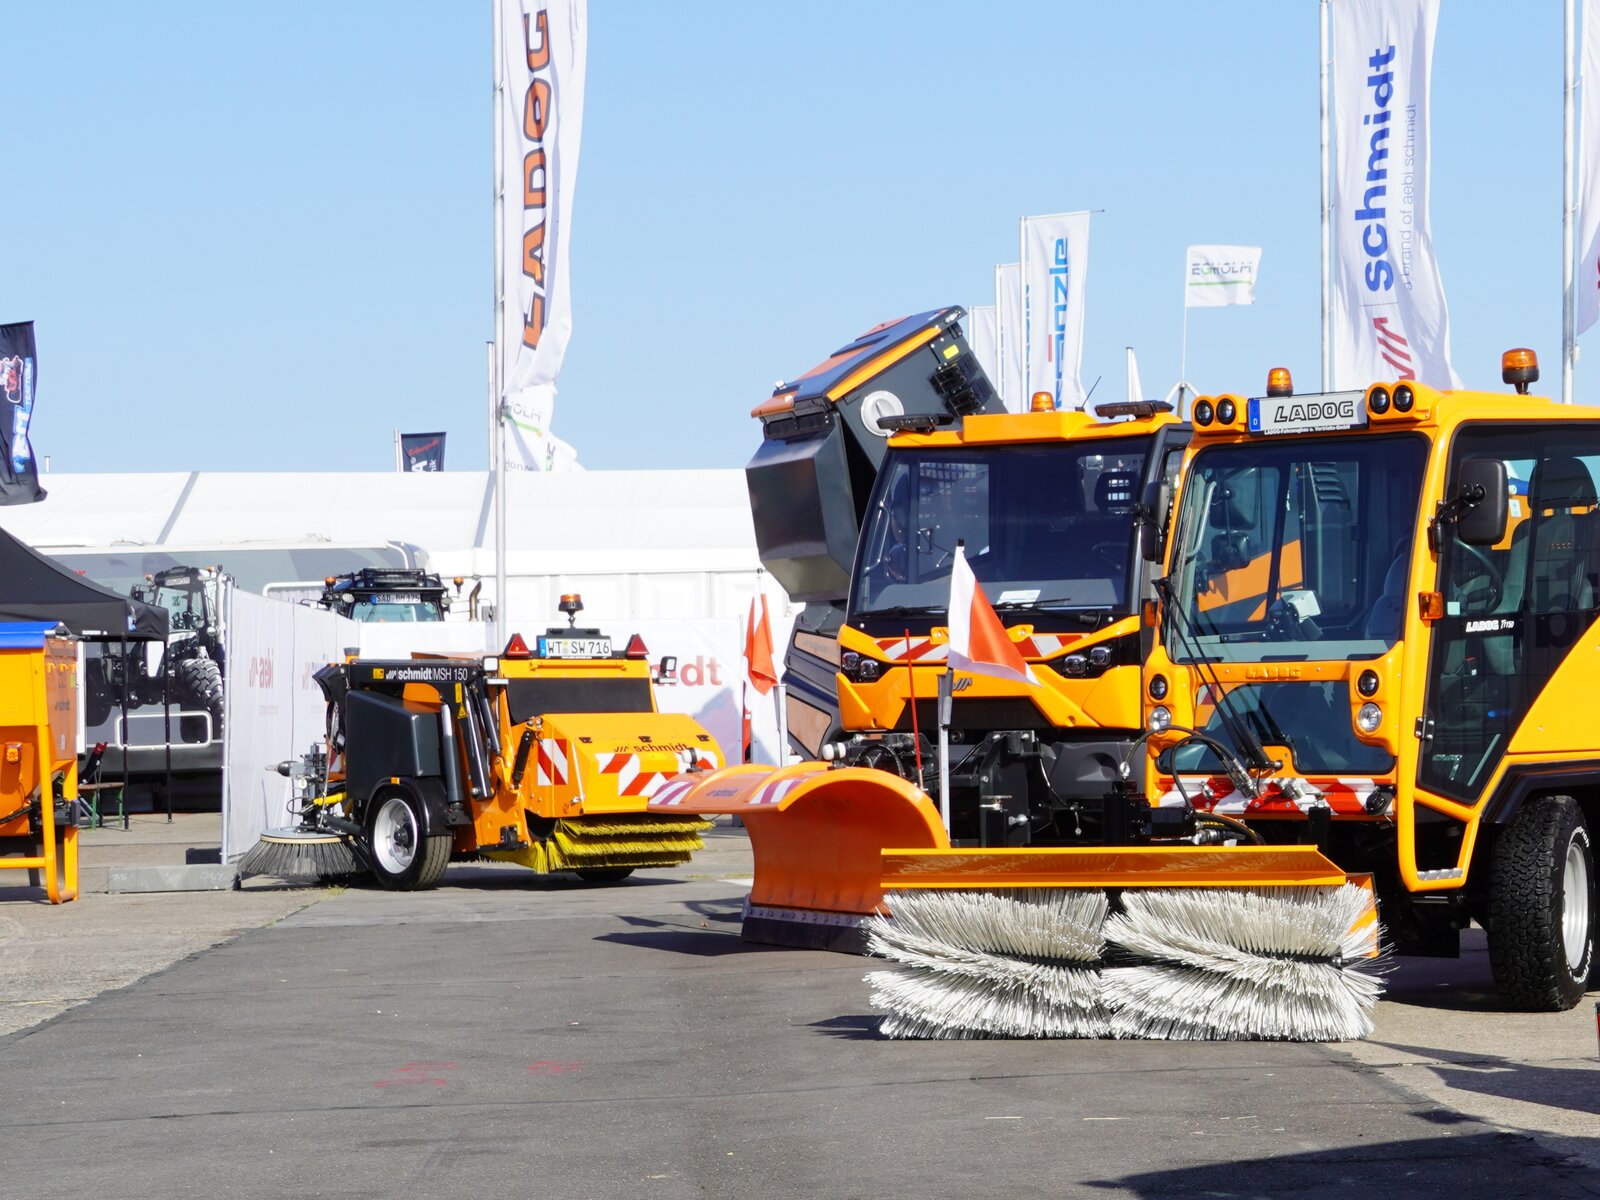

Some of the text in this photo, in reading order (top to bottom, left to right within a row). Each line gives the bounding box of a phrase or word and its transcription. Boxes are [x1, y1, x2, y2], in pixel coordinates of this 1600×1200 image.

[1404, 102, 1417, 170] schmidt
[1355, 45, 1396, 292] schmidt
[1402, 170, 1415, 205] aebi
[1402, 209, 1412, 225] of
[1402, 230, 1412, 279] brand
[1191, 262, 1253, 276] EGHOLM
[1274, 401, 1354, 423] LADOG
[1466, 620, 1500, 632] LADOG
[547, 642, 610, 654] WT SW 716
[398, 667, 468, 681] schmidt MSH 150
[634, 743, 689, 753] schmidt
